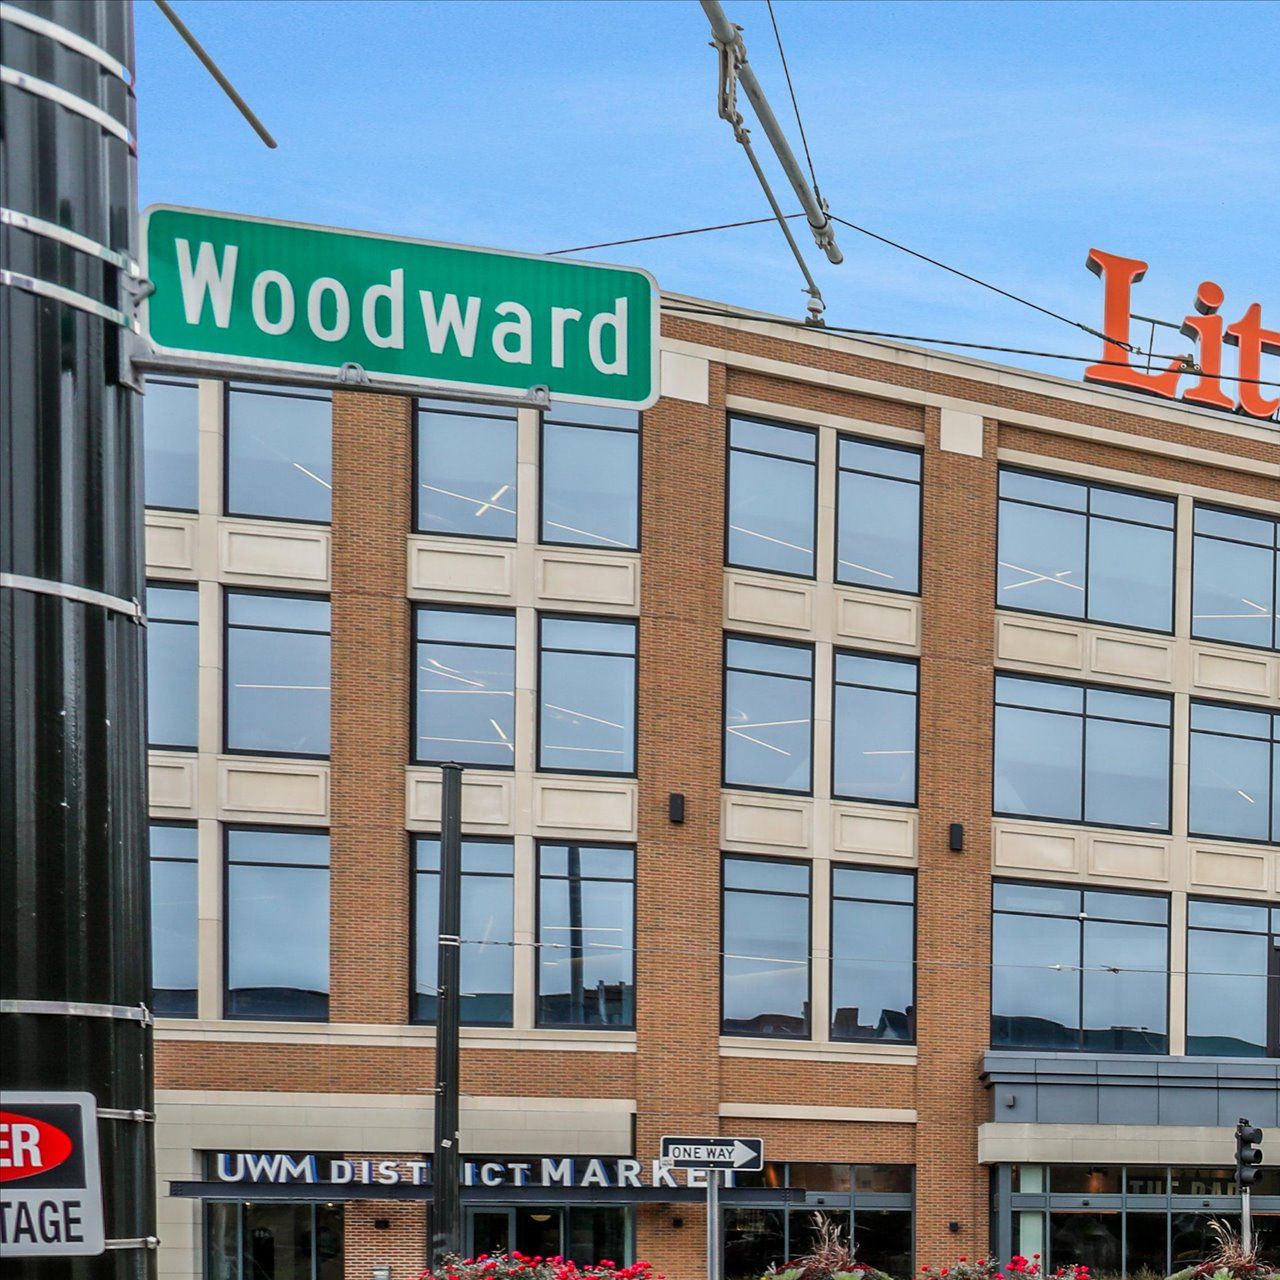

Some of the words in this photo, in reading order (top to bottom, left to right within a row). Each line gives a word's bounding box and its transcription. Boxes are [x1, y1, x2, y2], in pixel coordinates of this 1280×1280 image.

[175, 237, 628, 376] Woodward
[217, 1153, 318, 1184] UWM
[330, 1160, 531, 1187] DISTICT
[672, 1146, 701, 1159] ONE
[706, 1147, 735, 1160] WAY
[0, 1200, 84, 1244] TAGE
